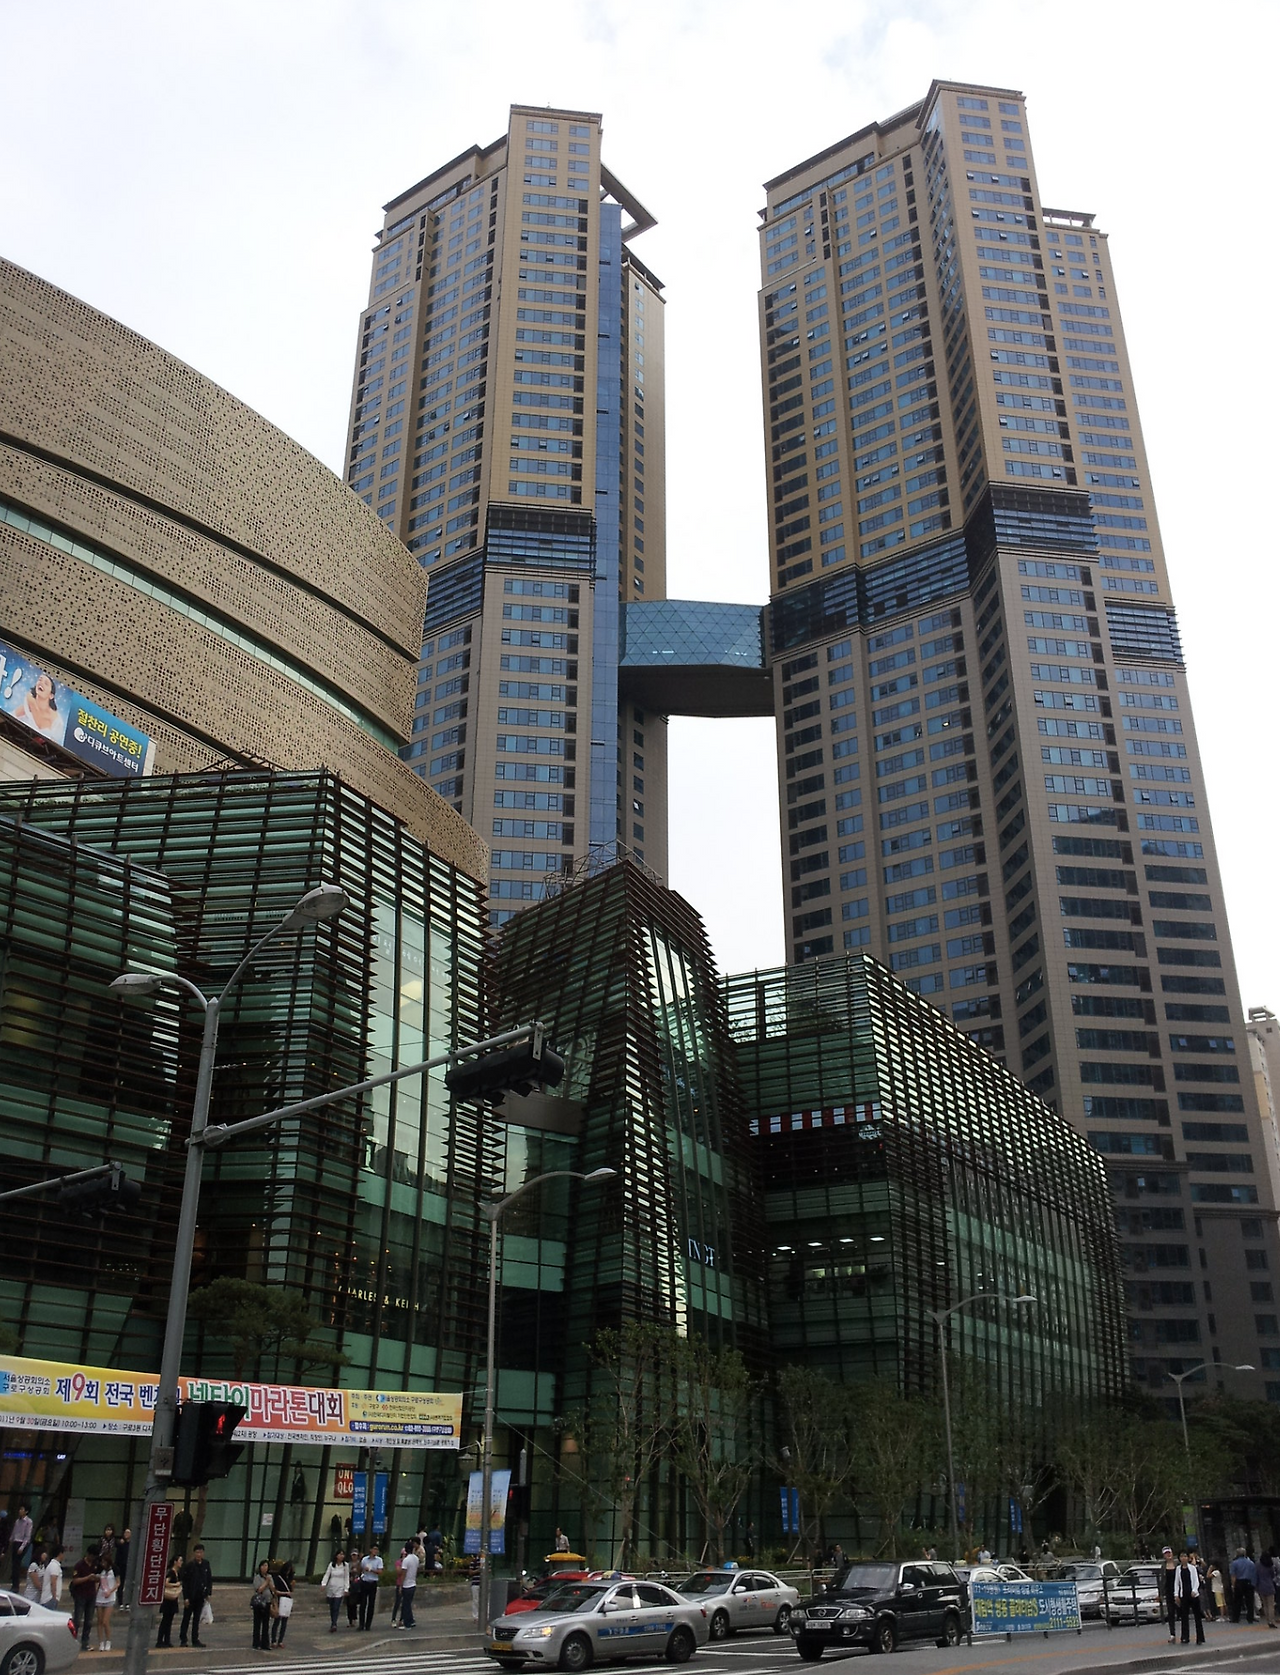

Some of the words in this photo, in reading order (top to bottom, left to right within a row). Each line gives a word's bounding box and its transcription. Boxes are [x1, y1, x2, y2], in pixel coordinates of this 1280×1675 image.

[78, 708, 108, 738] 절찬리
[109, 728, 143, 760] 공연중!
[87, 735, 139, 773] 디큐브아트센터
[2, 1383, 50, 1396] 구로구상공회
[3, 1373, 51, 1387] 서울상공회의소
[55, 1372, 100, 1405] 제9회
[104, 1382, 135, 1407] 전국
[145, 1506, 168, 1601] 무단횡단금지
